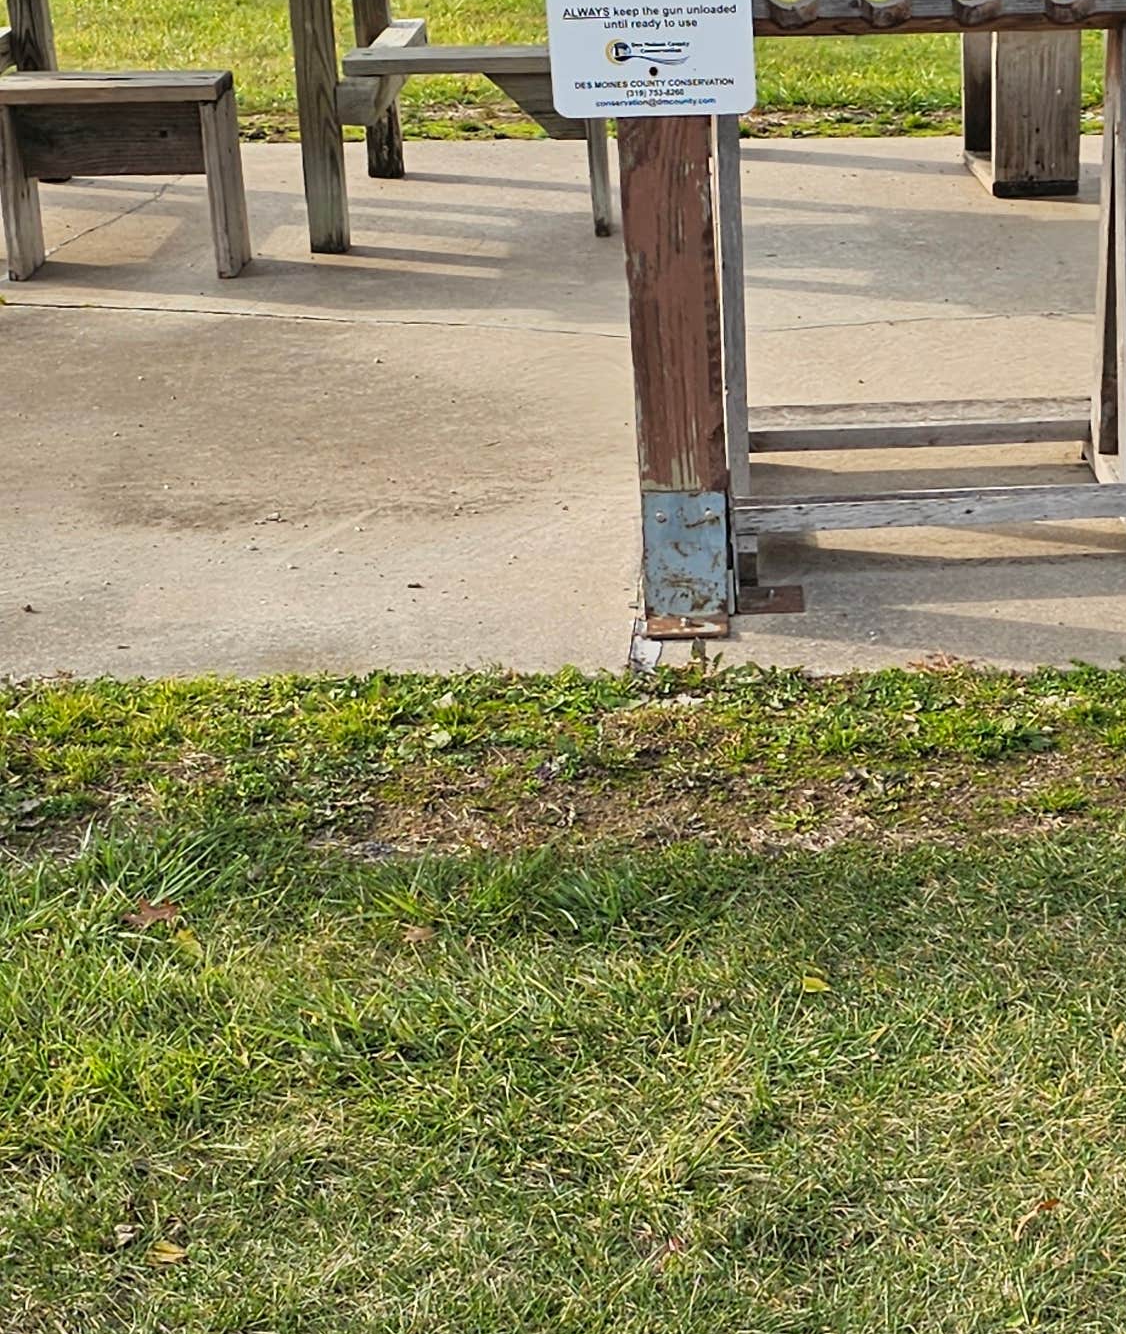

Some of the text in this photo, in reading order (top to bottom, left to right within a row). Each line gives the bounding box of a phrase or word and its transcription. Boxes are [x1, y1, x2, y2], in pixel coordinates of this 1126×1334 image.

[563, 5, 736, 19] ALWAYS keep the gun unloaded
[604, 20, 628, 29] until
[631, 20, 661, 30] ready
[665, 19, 675, 28] to
[575, 78, 734, 90] DES MOINES COUNTY CONSERVATION
[626, 90, 647, 98] (319)
[596, 98, 716, 107] conservation@dmcounty.com
